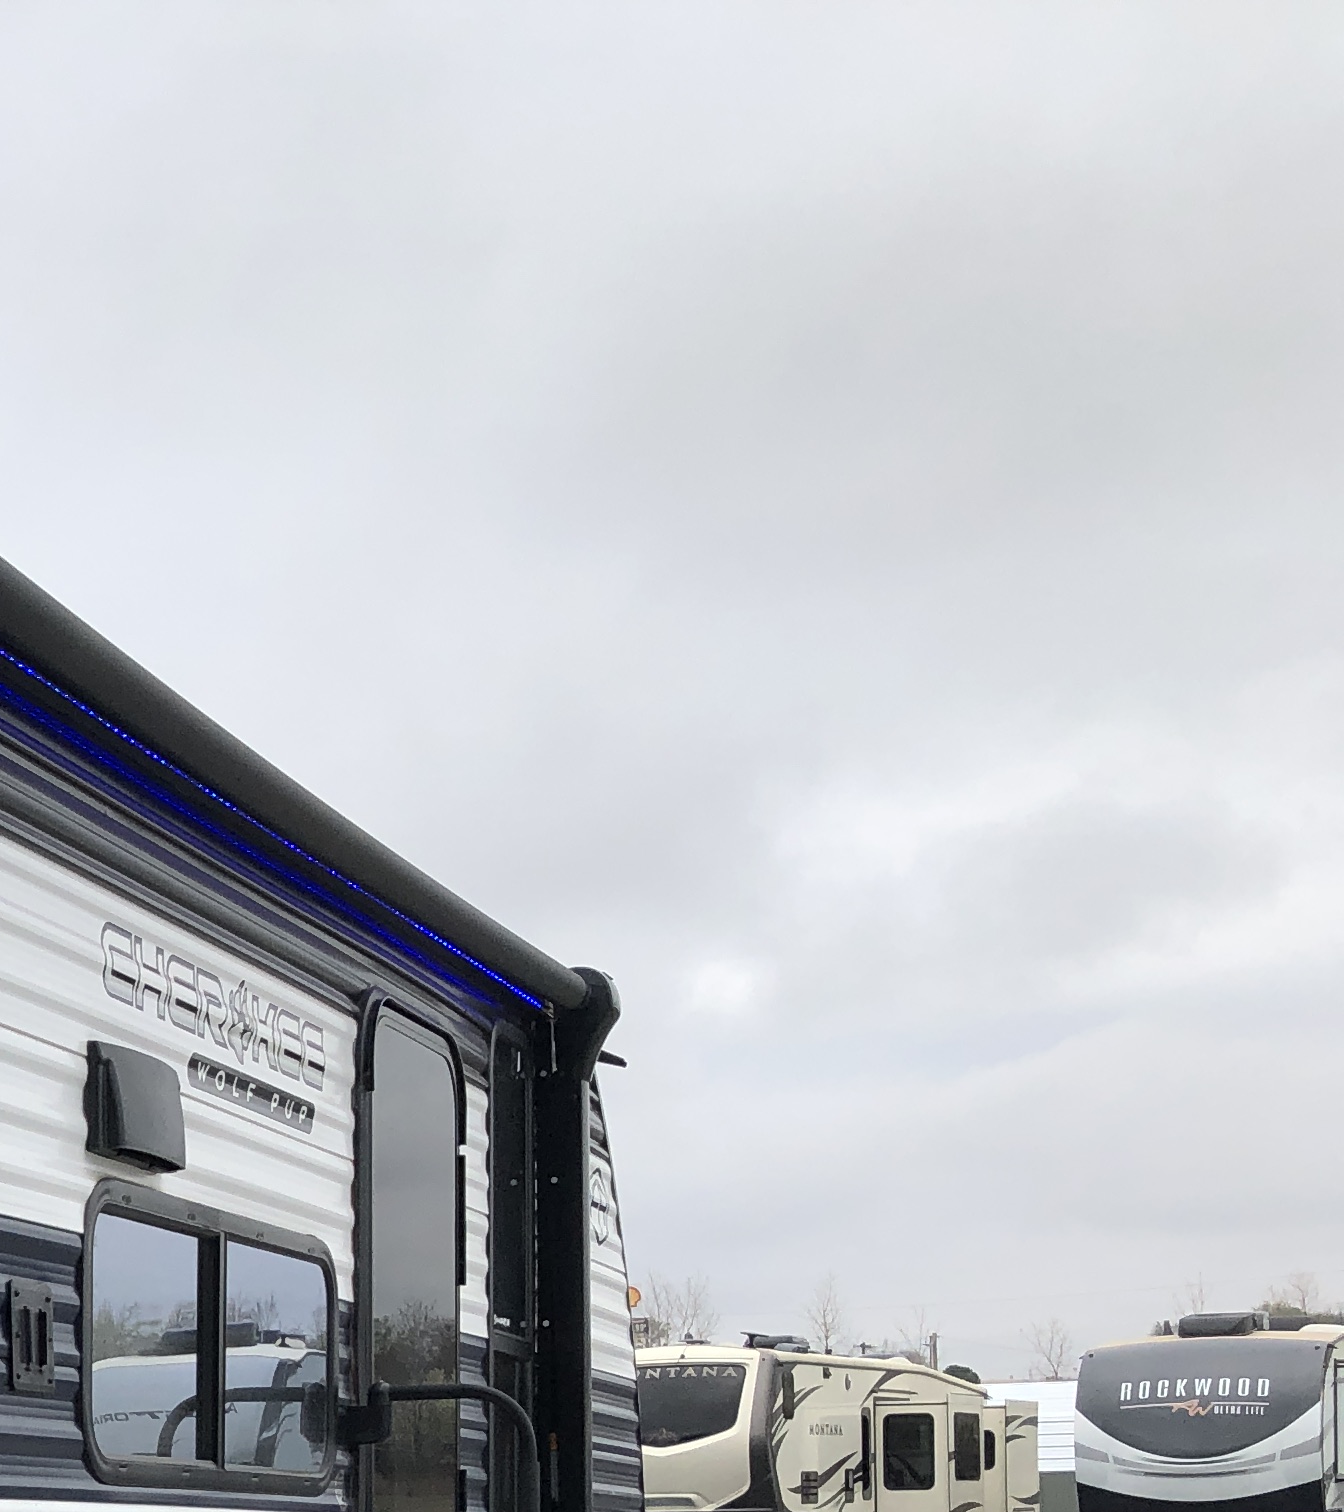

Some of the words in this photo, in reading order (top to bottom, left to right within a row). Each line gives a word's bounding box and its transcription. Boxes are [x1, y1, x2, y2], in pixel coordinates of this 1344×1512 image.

[196, 1061, 257, 1102] WOLF
[270, 1092, 309, 1124] PUP
[637, 1366, 738, 1380] NTANA
[1119, 1377, 1270, 1401] ROCKWOOD
